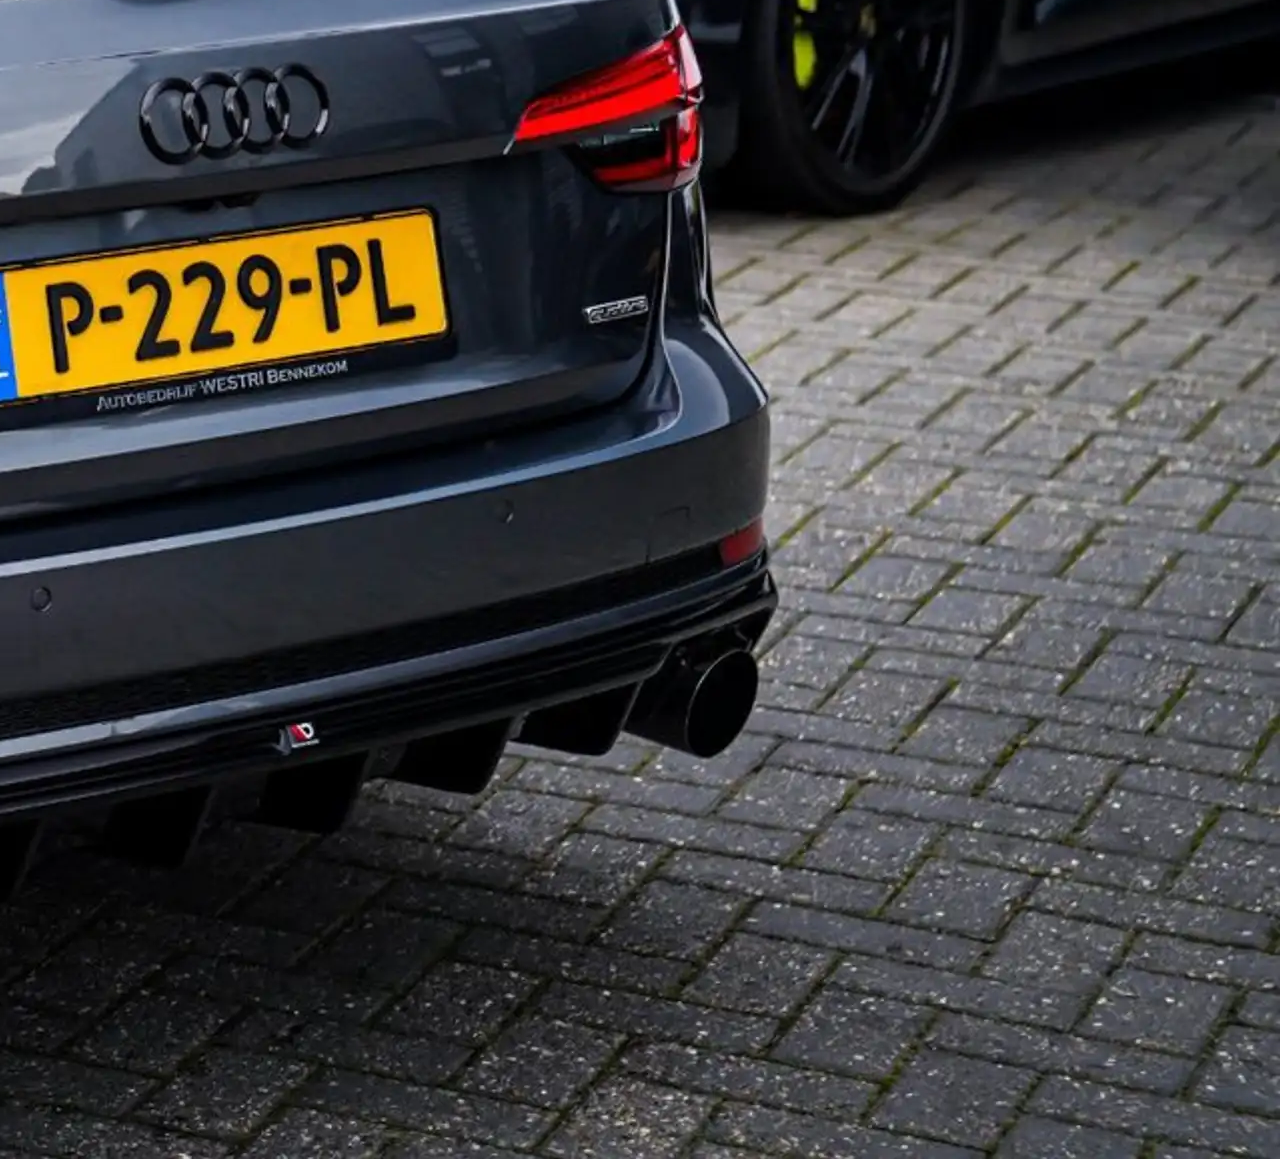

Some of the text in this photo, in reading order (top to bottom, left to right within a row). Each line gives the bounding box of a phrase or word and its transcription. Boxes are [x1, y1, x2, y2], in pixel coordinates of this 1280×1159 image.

[45, 238, 417, 375] P-229-PL
[200, 371, 264, 396] WESTRI
[267, 359, 349, 385] BENNEKOM
